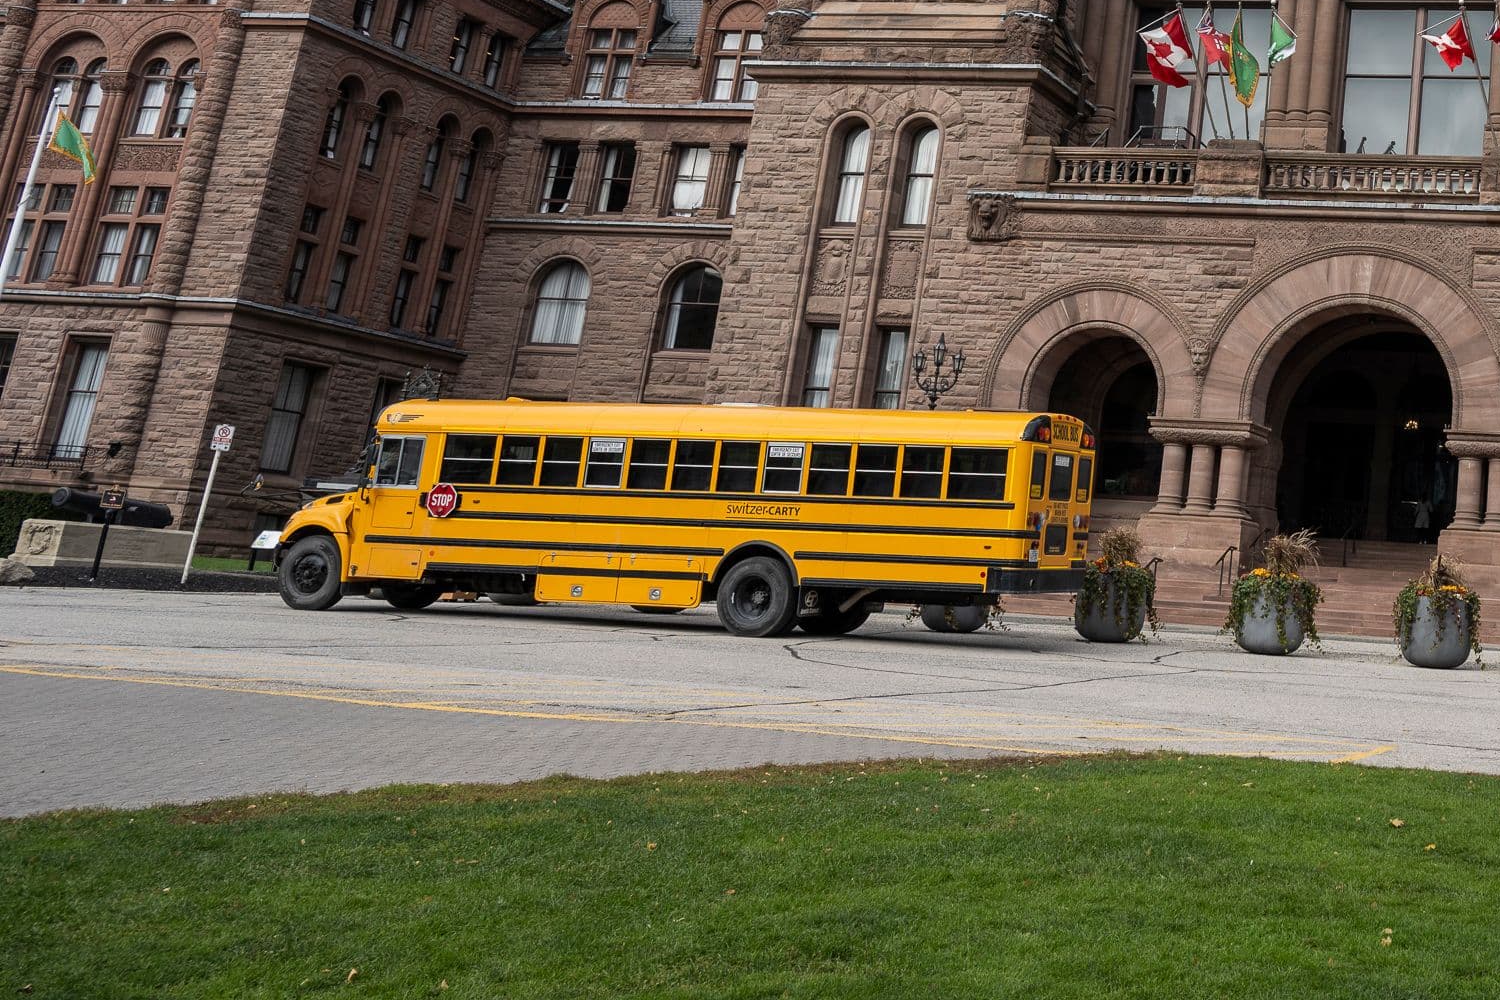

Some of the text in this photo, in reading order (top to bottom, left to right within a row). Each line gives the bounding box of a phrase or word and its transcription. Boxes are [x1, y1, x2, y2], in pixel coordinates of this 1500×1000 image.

[1053, 423, 1079, 442] SCHOOL BUS
[431, 493, 453, 507] STOP
